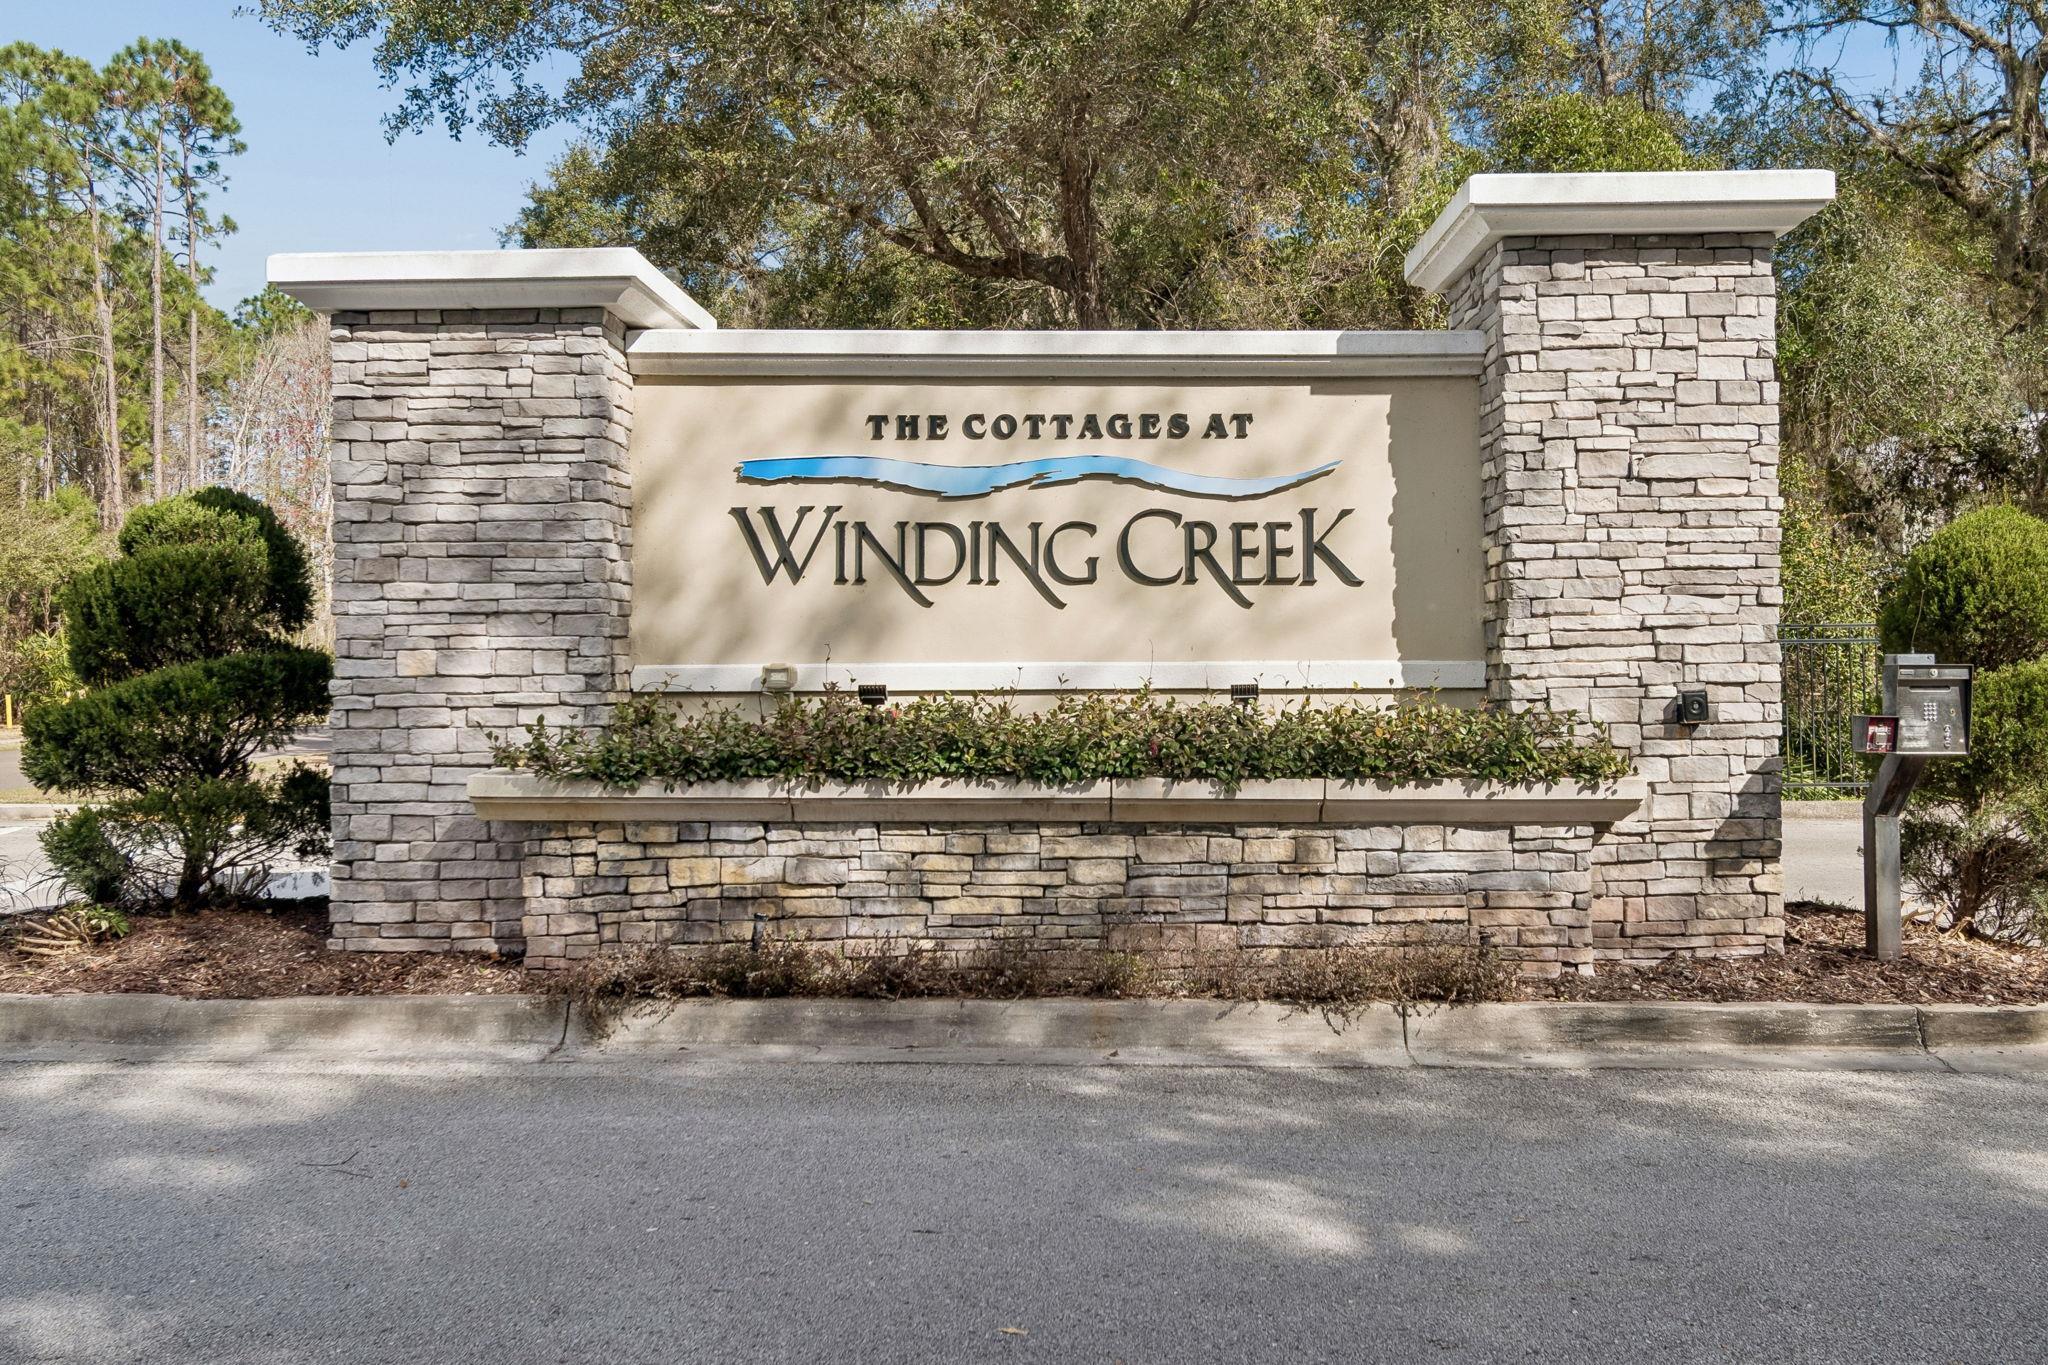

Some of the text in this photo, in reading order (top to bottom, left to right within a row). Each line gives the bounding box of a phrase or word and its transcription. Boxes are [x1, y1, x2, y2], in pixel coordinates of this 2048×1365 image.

[864, 413, 1254, 441] THE COTTAGES AT
[728, 505, 1365, 610] WINDING CREEK
